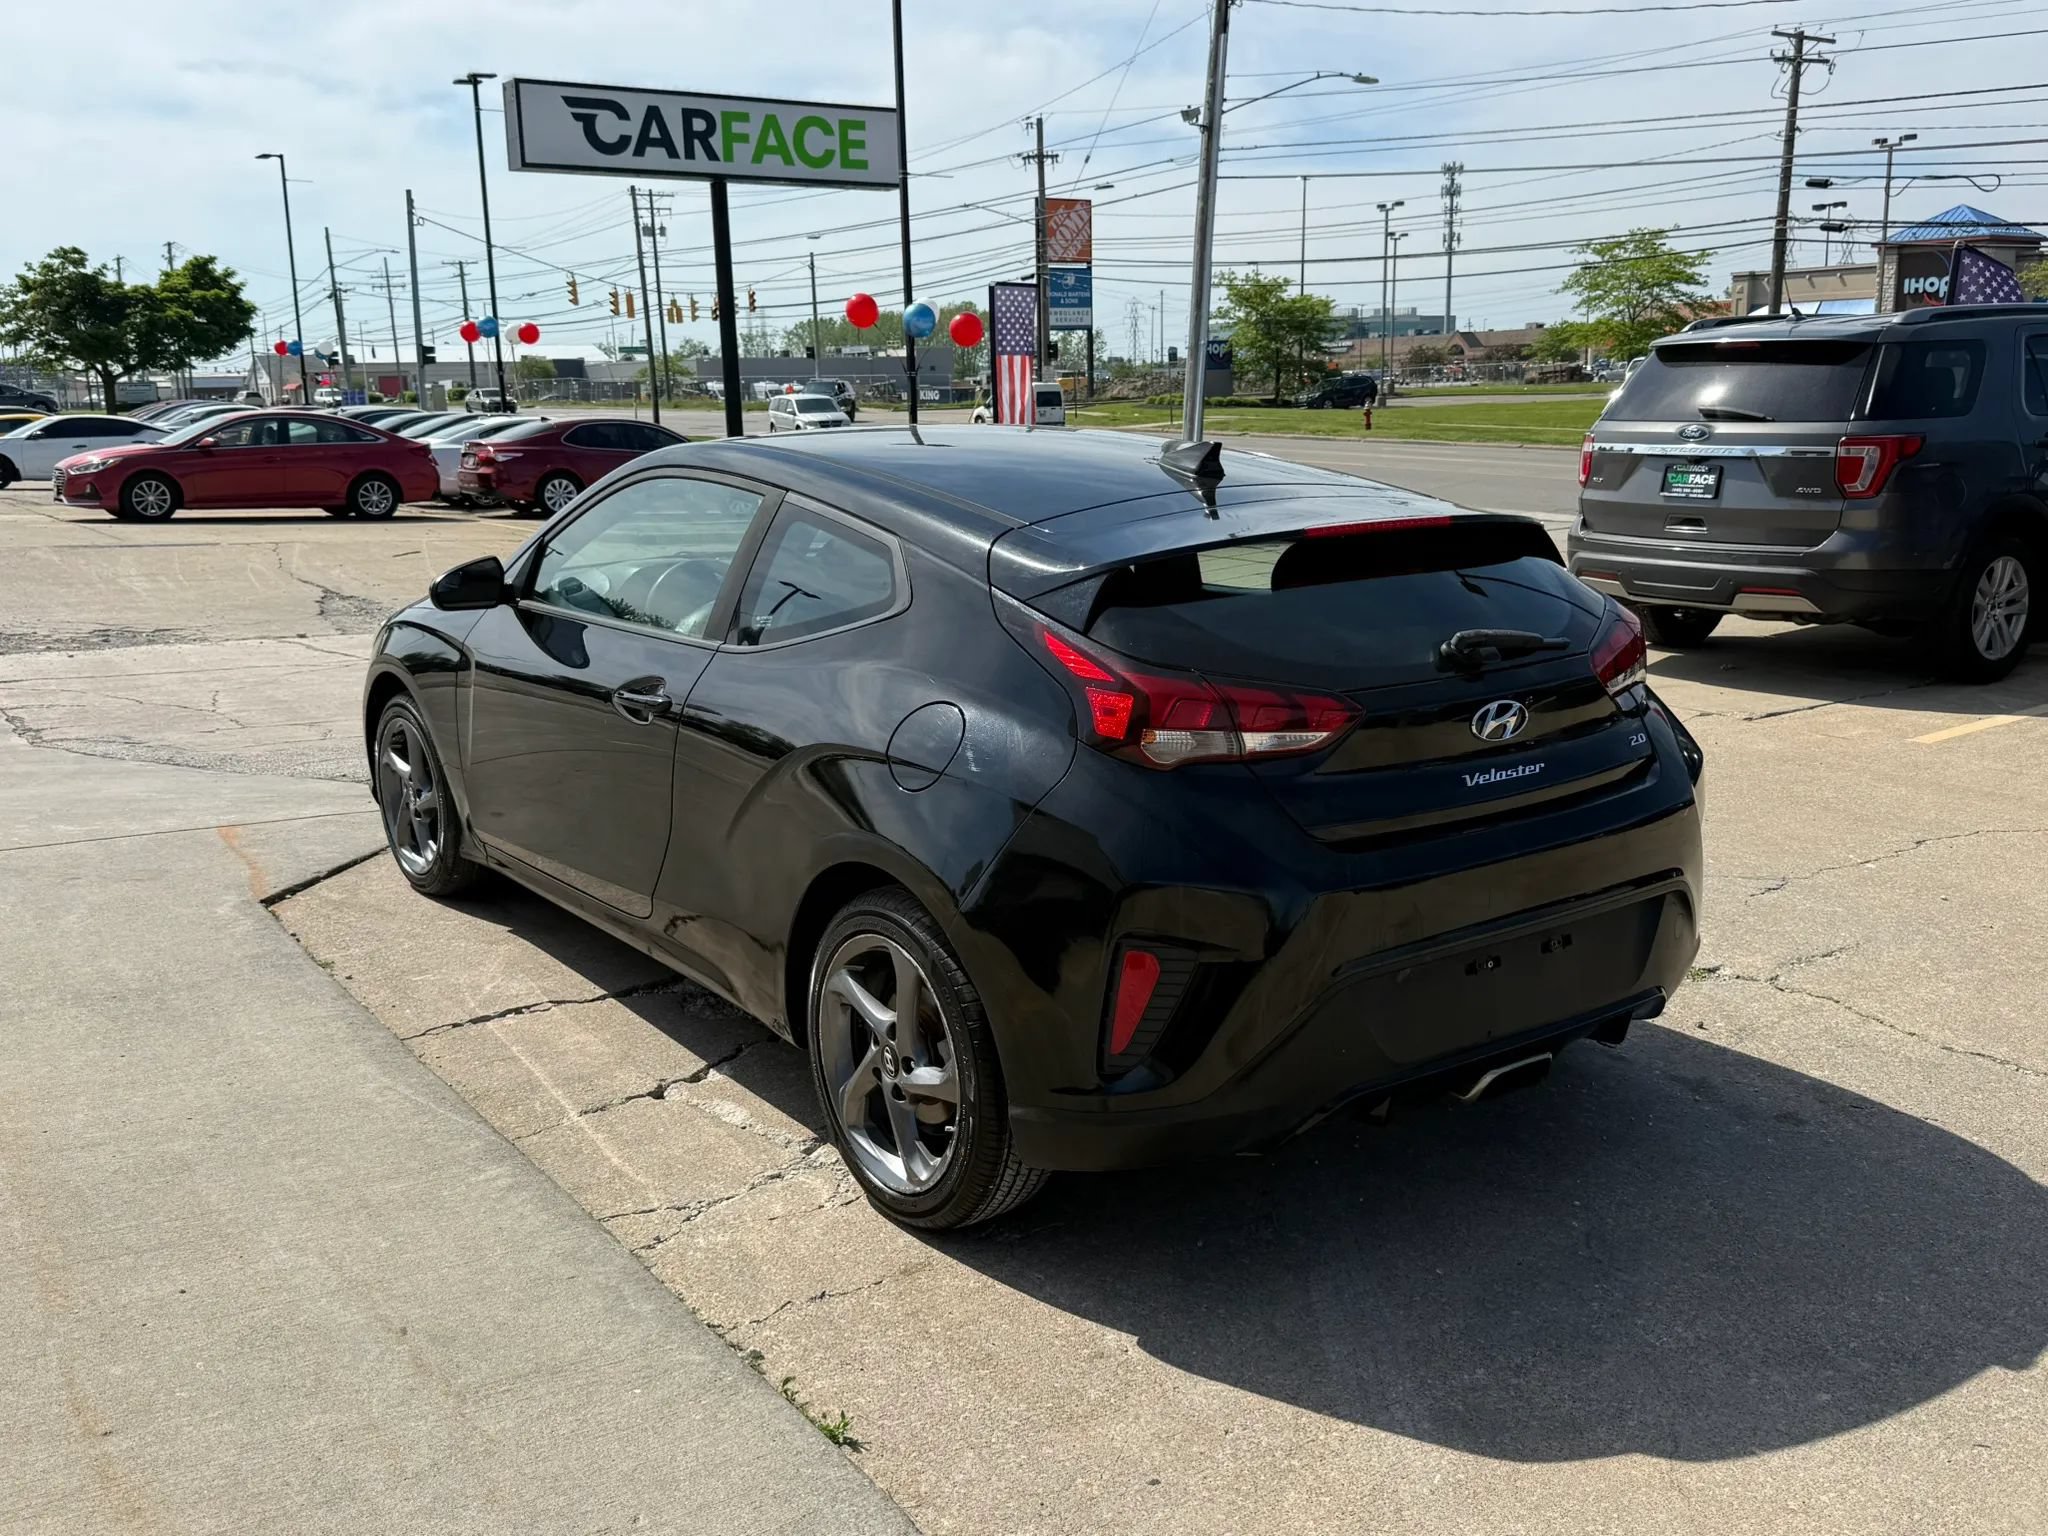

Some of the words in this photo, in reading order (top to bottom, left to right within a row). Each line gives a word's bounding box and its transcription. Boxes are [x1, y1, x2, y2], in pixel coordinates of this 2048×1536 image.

[561, 95, 869, 170] CARFACE
[1667, 473, 1716, 485] CARFACE
[1461, 763, 1545, 787] Veloster
